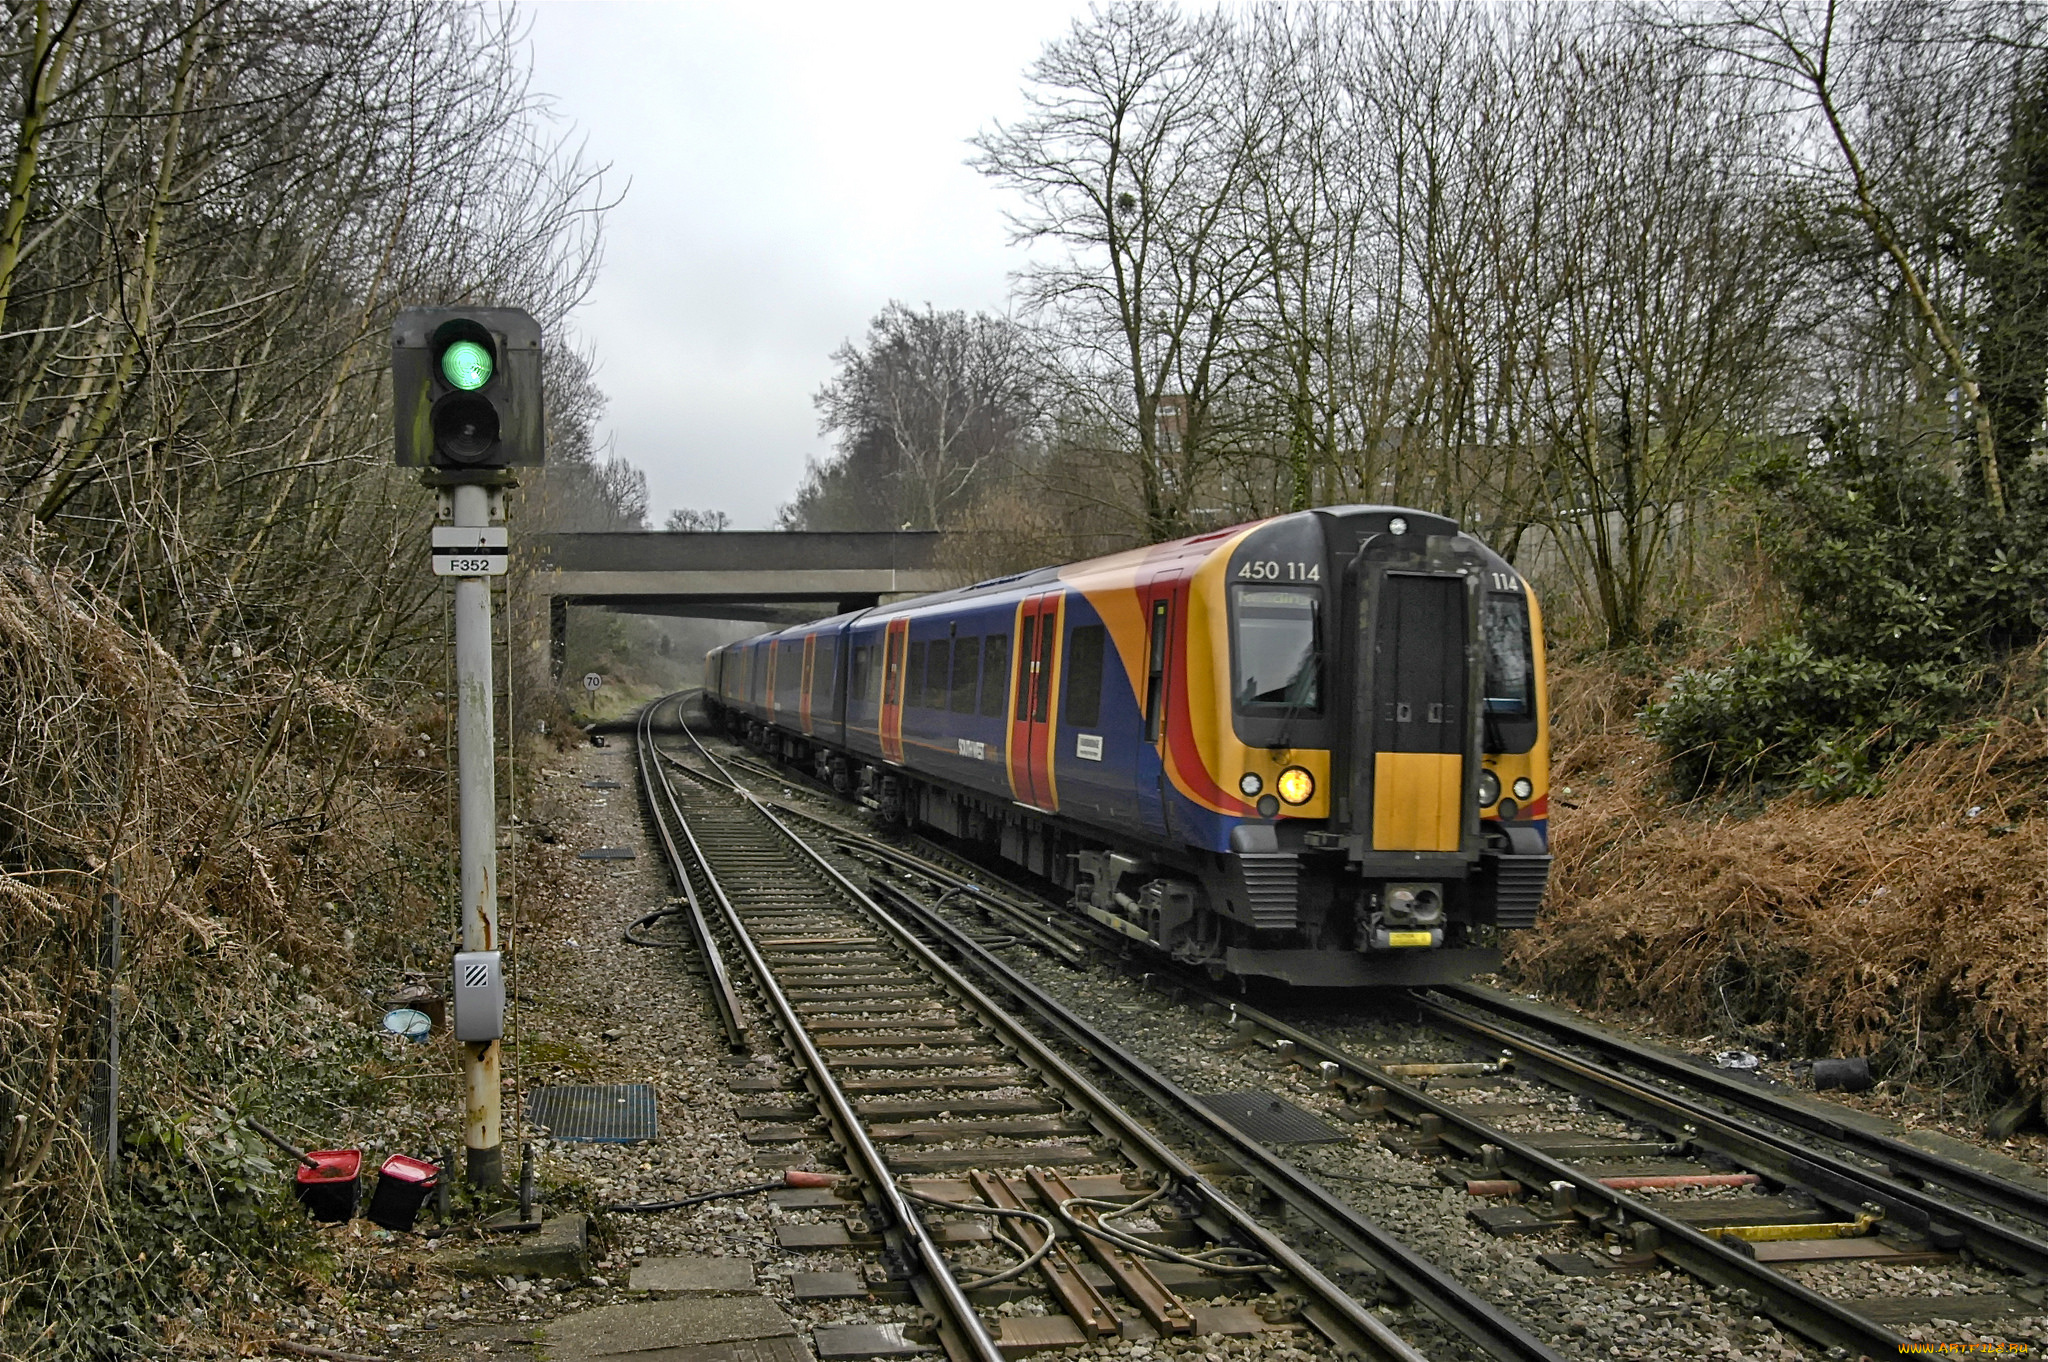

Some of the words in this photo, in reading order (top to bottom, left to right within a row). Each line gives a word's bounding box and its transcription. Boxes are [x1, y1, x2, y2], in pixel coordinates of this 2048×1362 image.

[450, 560, 490, 572] F352
[1237, 561, 1280, 580] 450
[1287, 561, 1321, 581] 114
[1491, 572, 1519, 592] 114
[586, 676, 600, 687] 70
